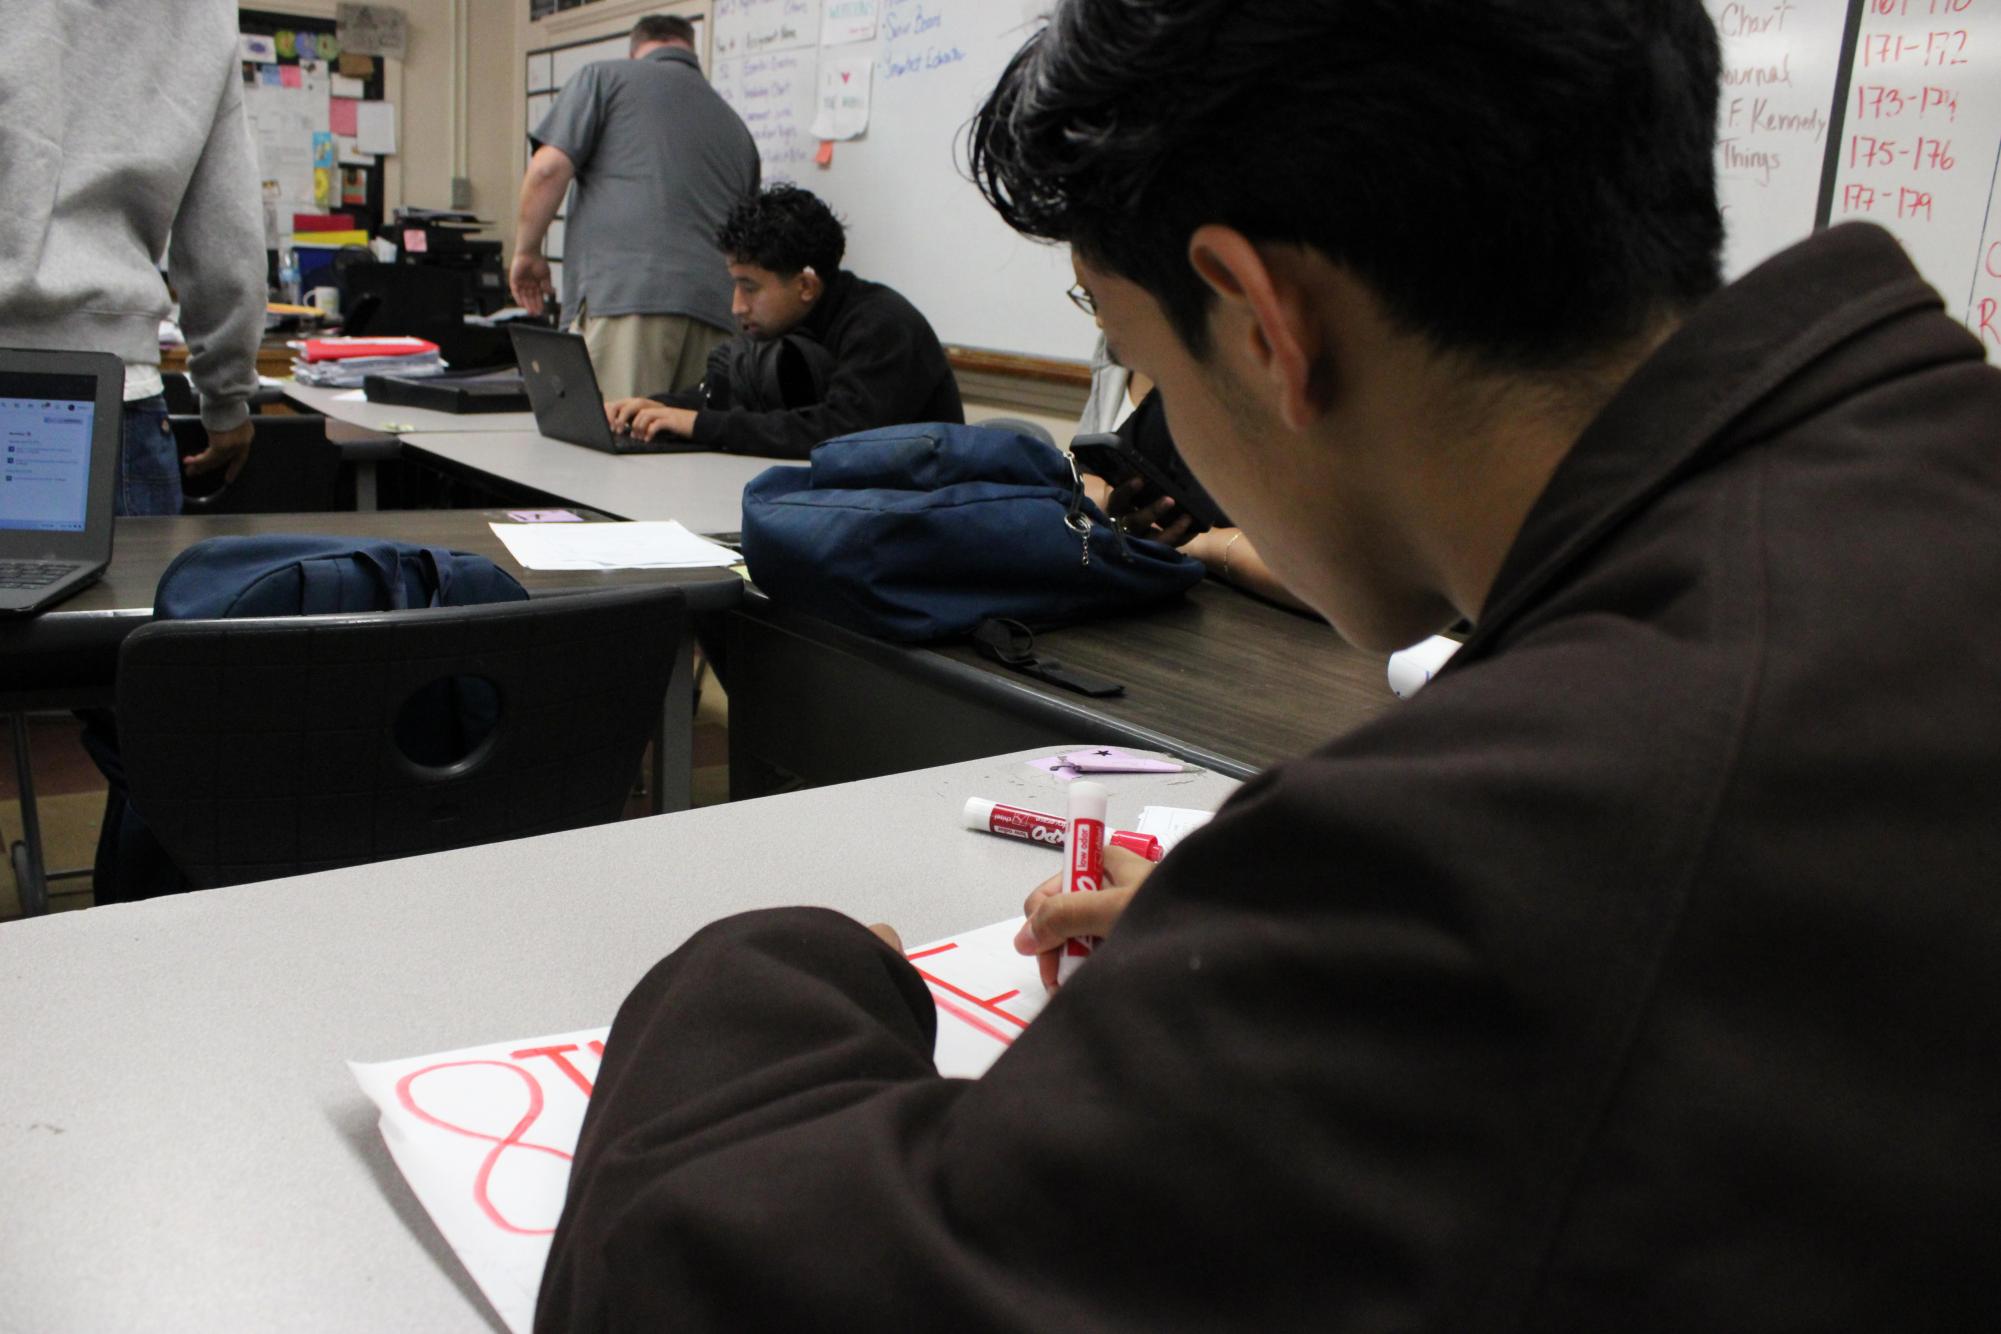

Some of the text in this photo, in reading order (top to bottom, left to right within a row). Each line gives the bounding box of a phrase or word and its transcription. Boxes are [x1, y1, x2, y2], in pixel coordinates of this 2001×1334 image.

[1864, 29, 1969, 67] 171-172
[1722, 53, 1792, 88] ournal
[1715, 137, 1781, 188] Things
[1850, 135, 1955, 171] 175-176
[1078, 828, 1089, 850] odor
[1078, 852, 1087, 868] low
